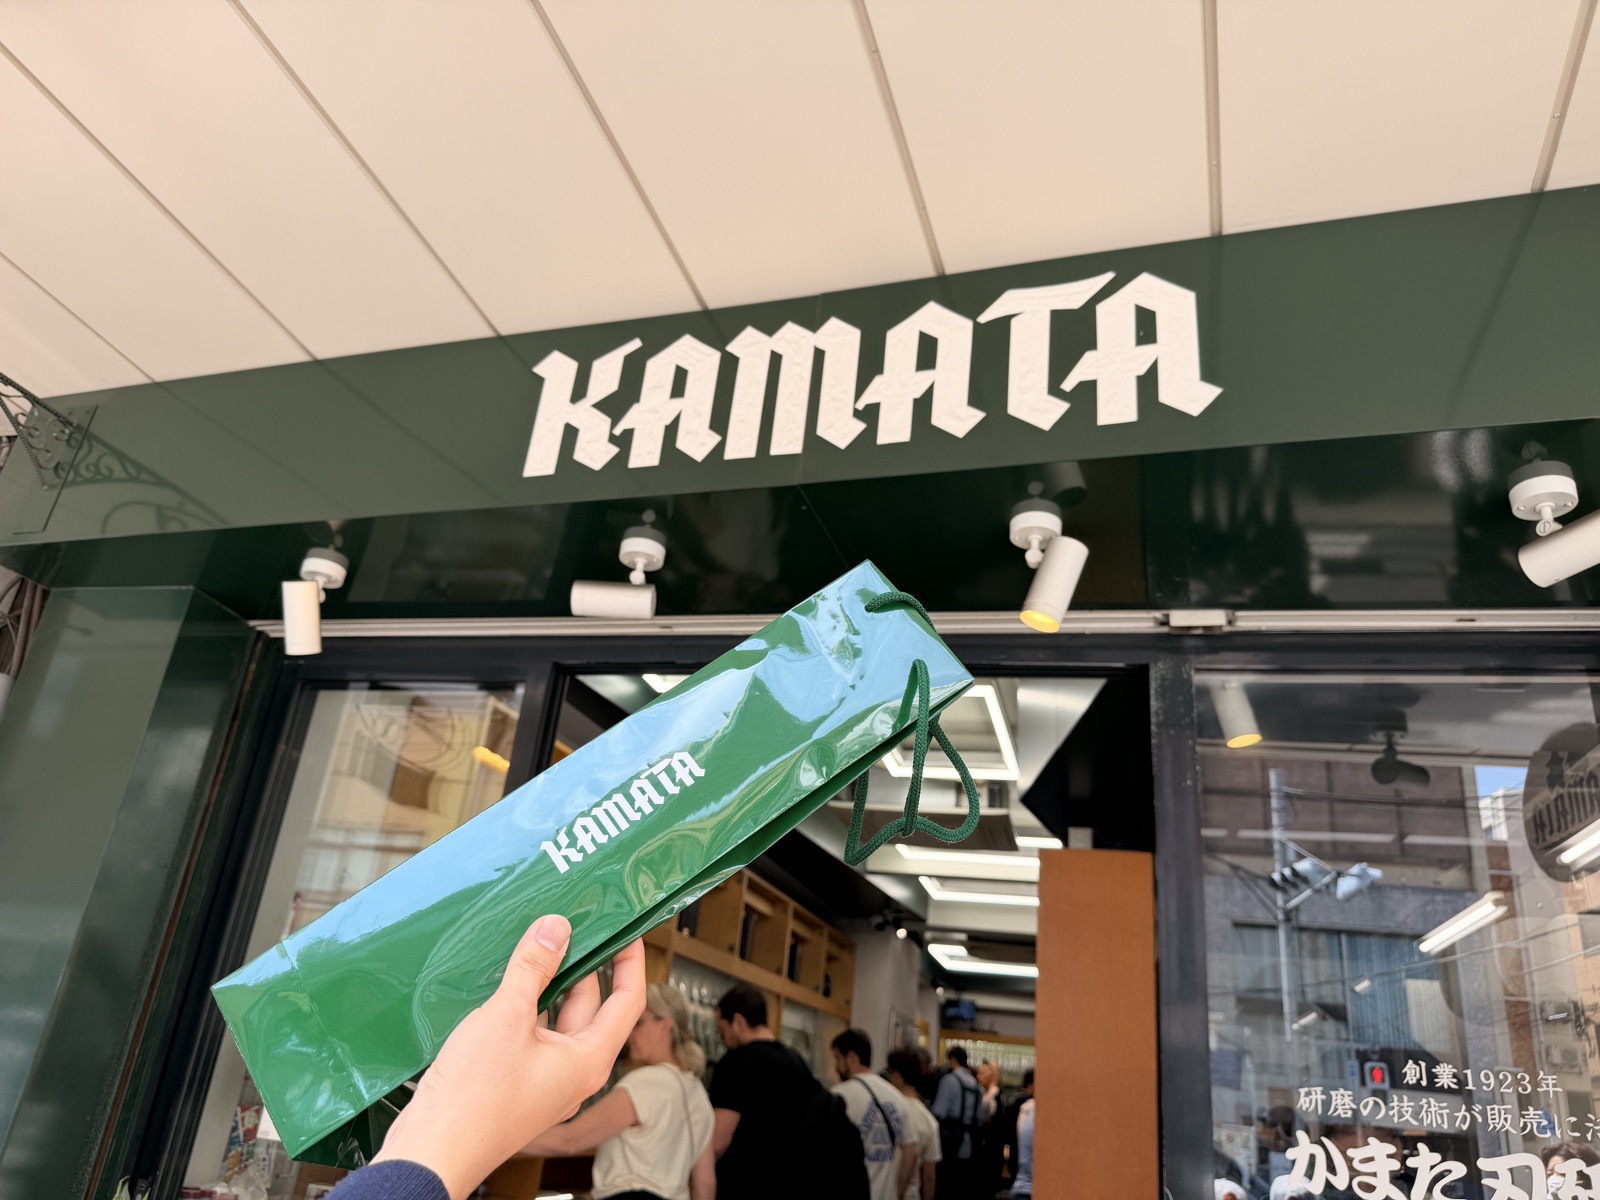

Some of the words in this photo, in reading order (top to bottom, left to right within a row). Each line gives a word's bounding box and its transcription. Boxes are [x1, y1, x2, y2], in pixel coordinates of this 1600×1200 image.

[522, 271, 1224, 478] KAMATA
[540, 751, 706, 874] KAMATA
[1401, 1059, 1563, 1099] 創業1923年
